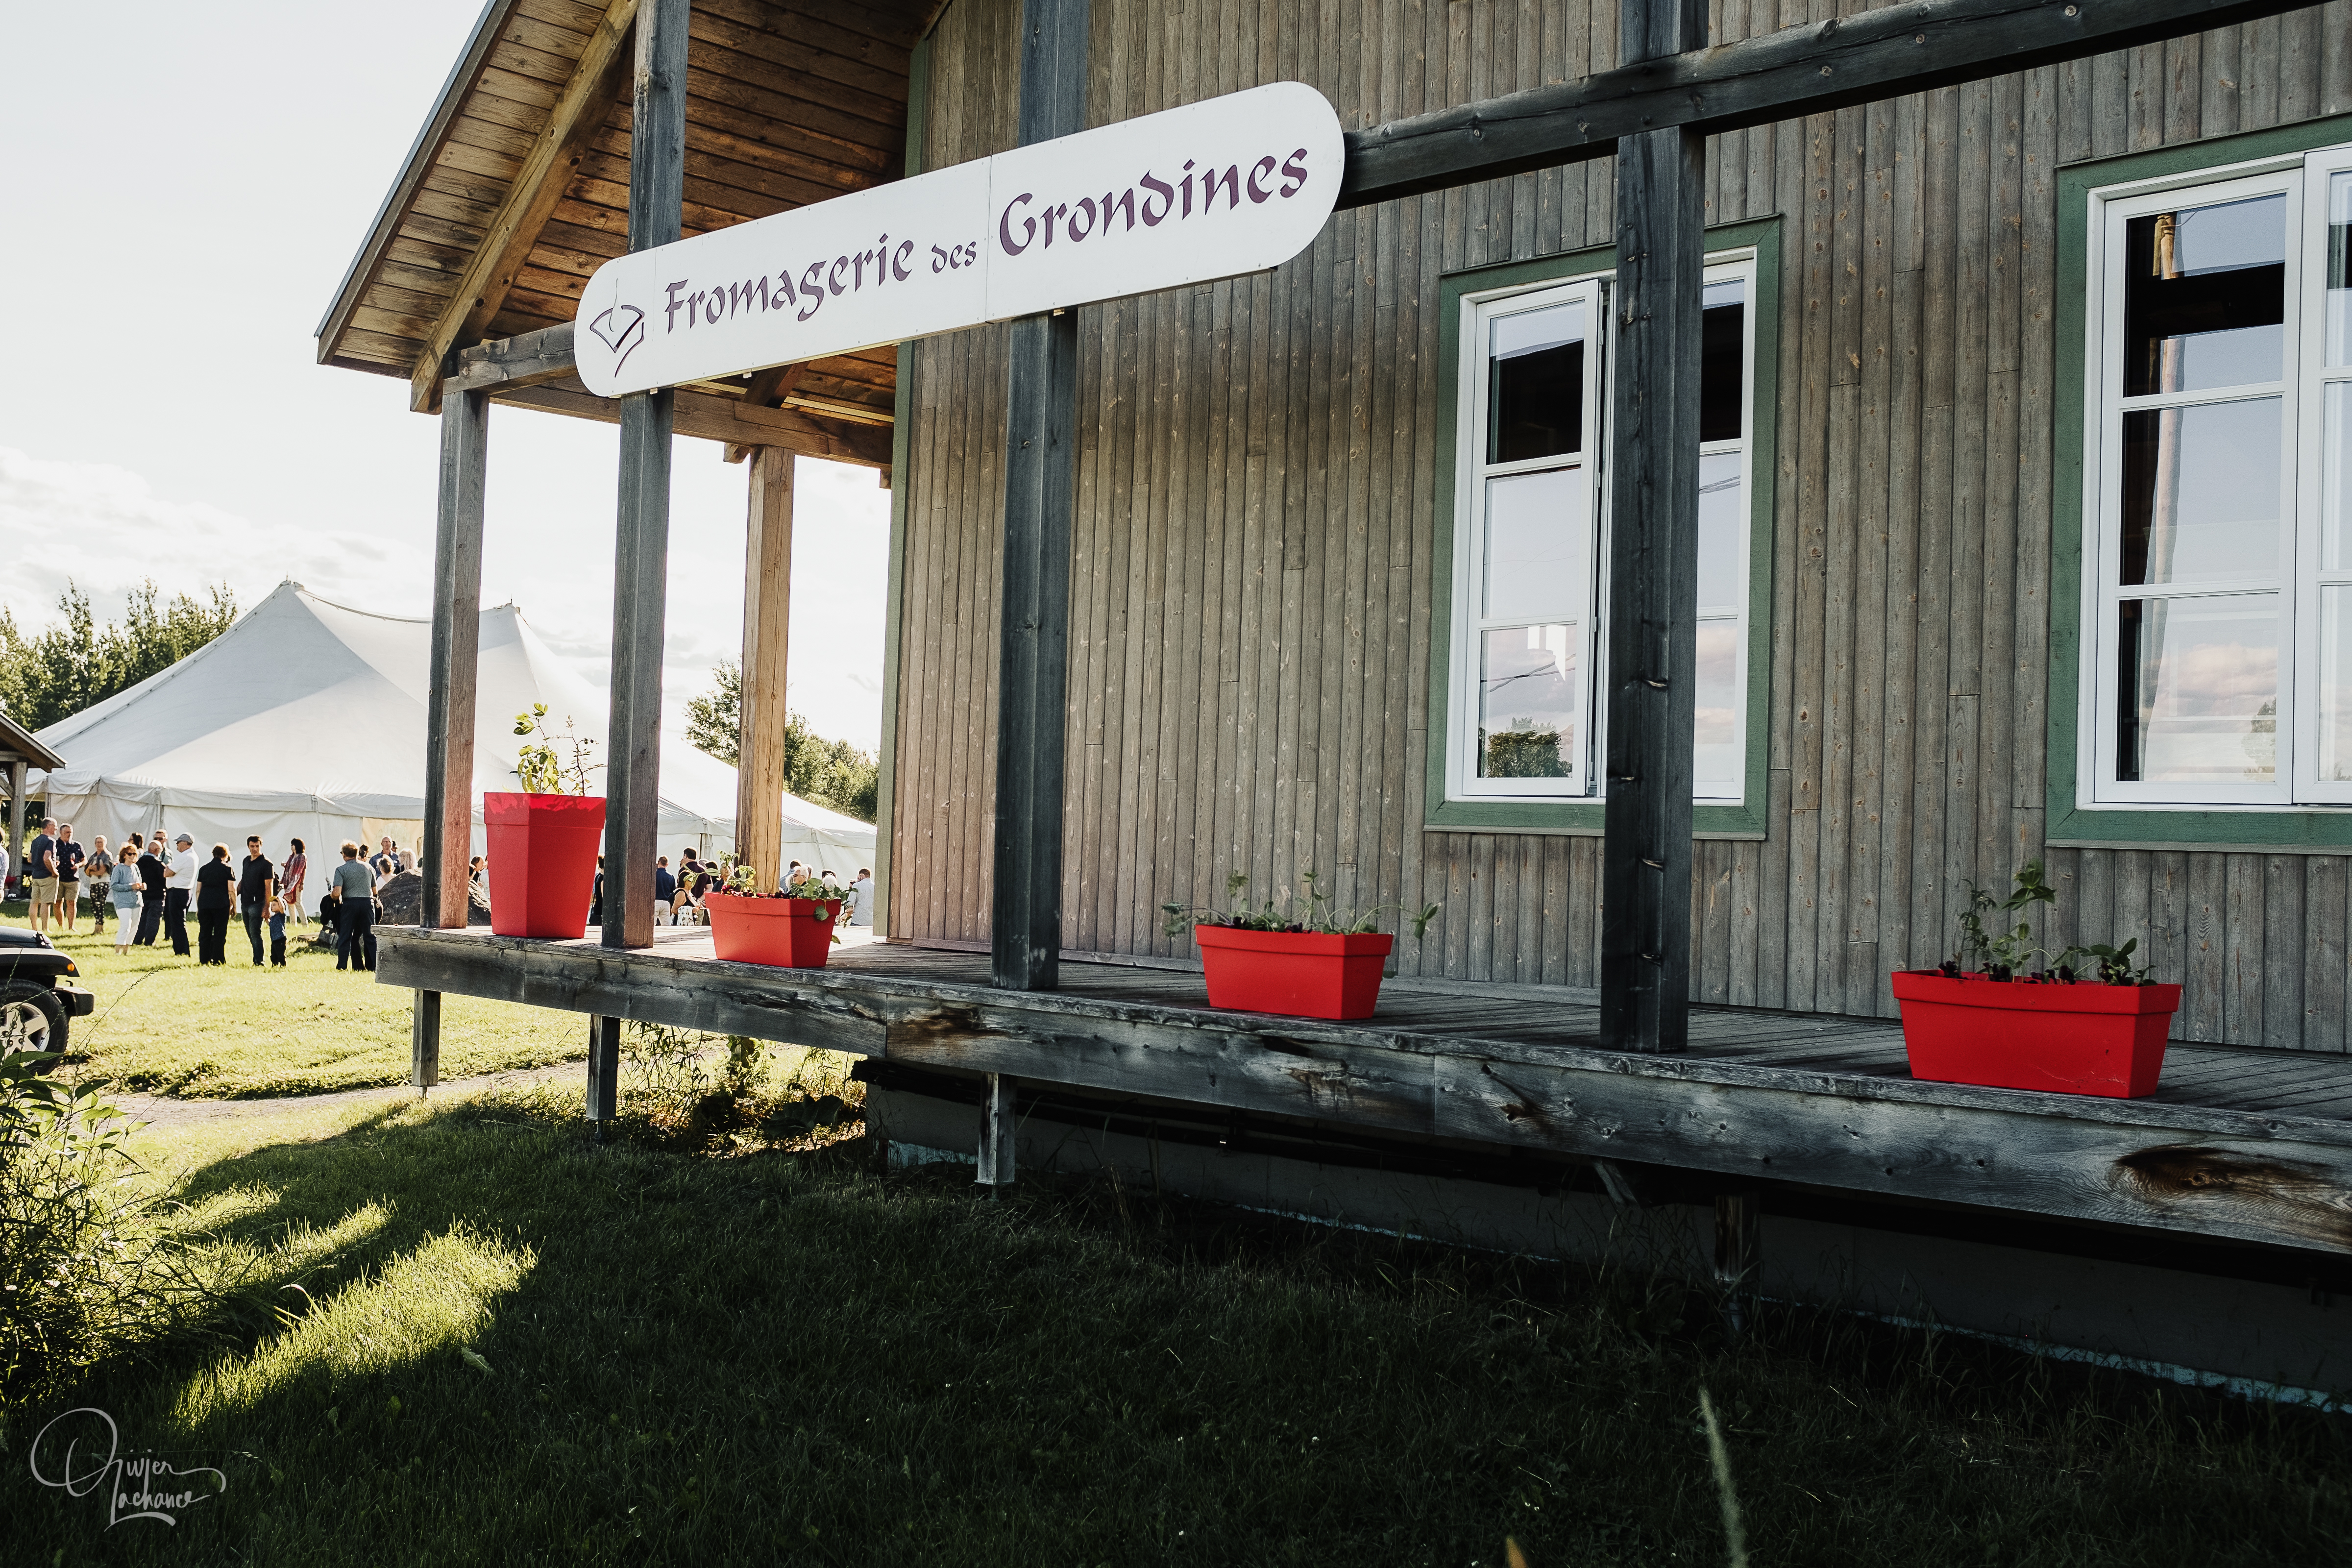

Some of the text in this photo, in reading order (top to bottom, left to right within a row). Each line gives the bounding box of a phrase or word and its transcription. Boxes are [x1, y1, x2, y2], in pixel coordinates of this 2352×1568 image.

[664, 148, 1308, 335] Fromagerie des Grondines
